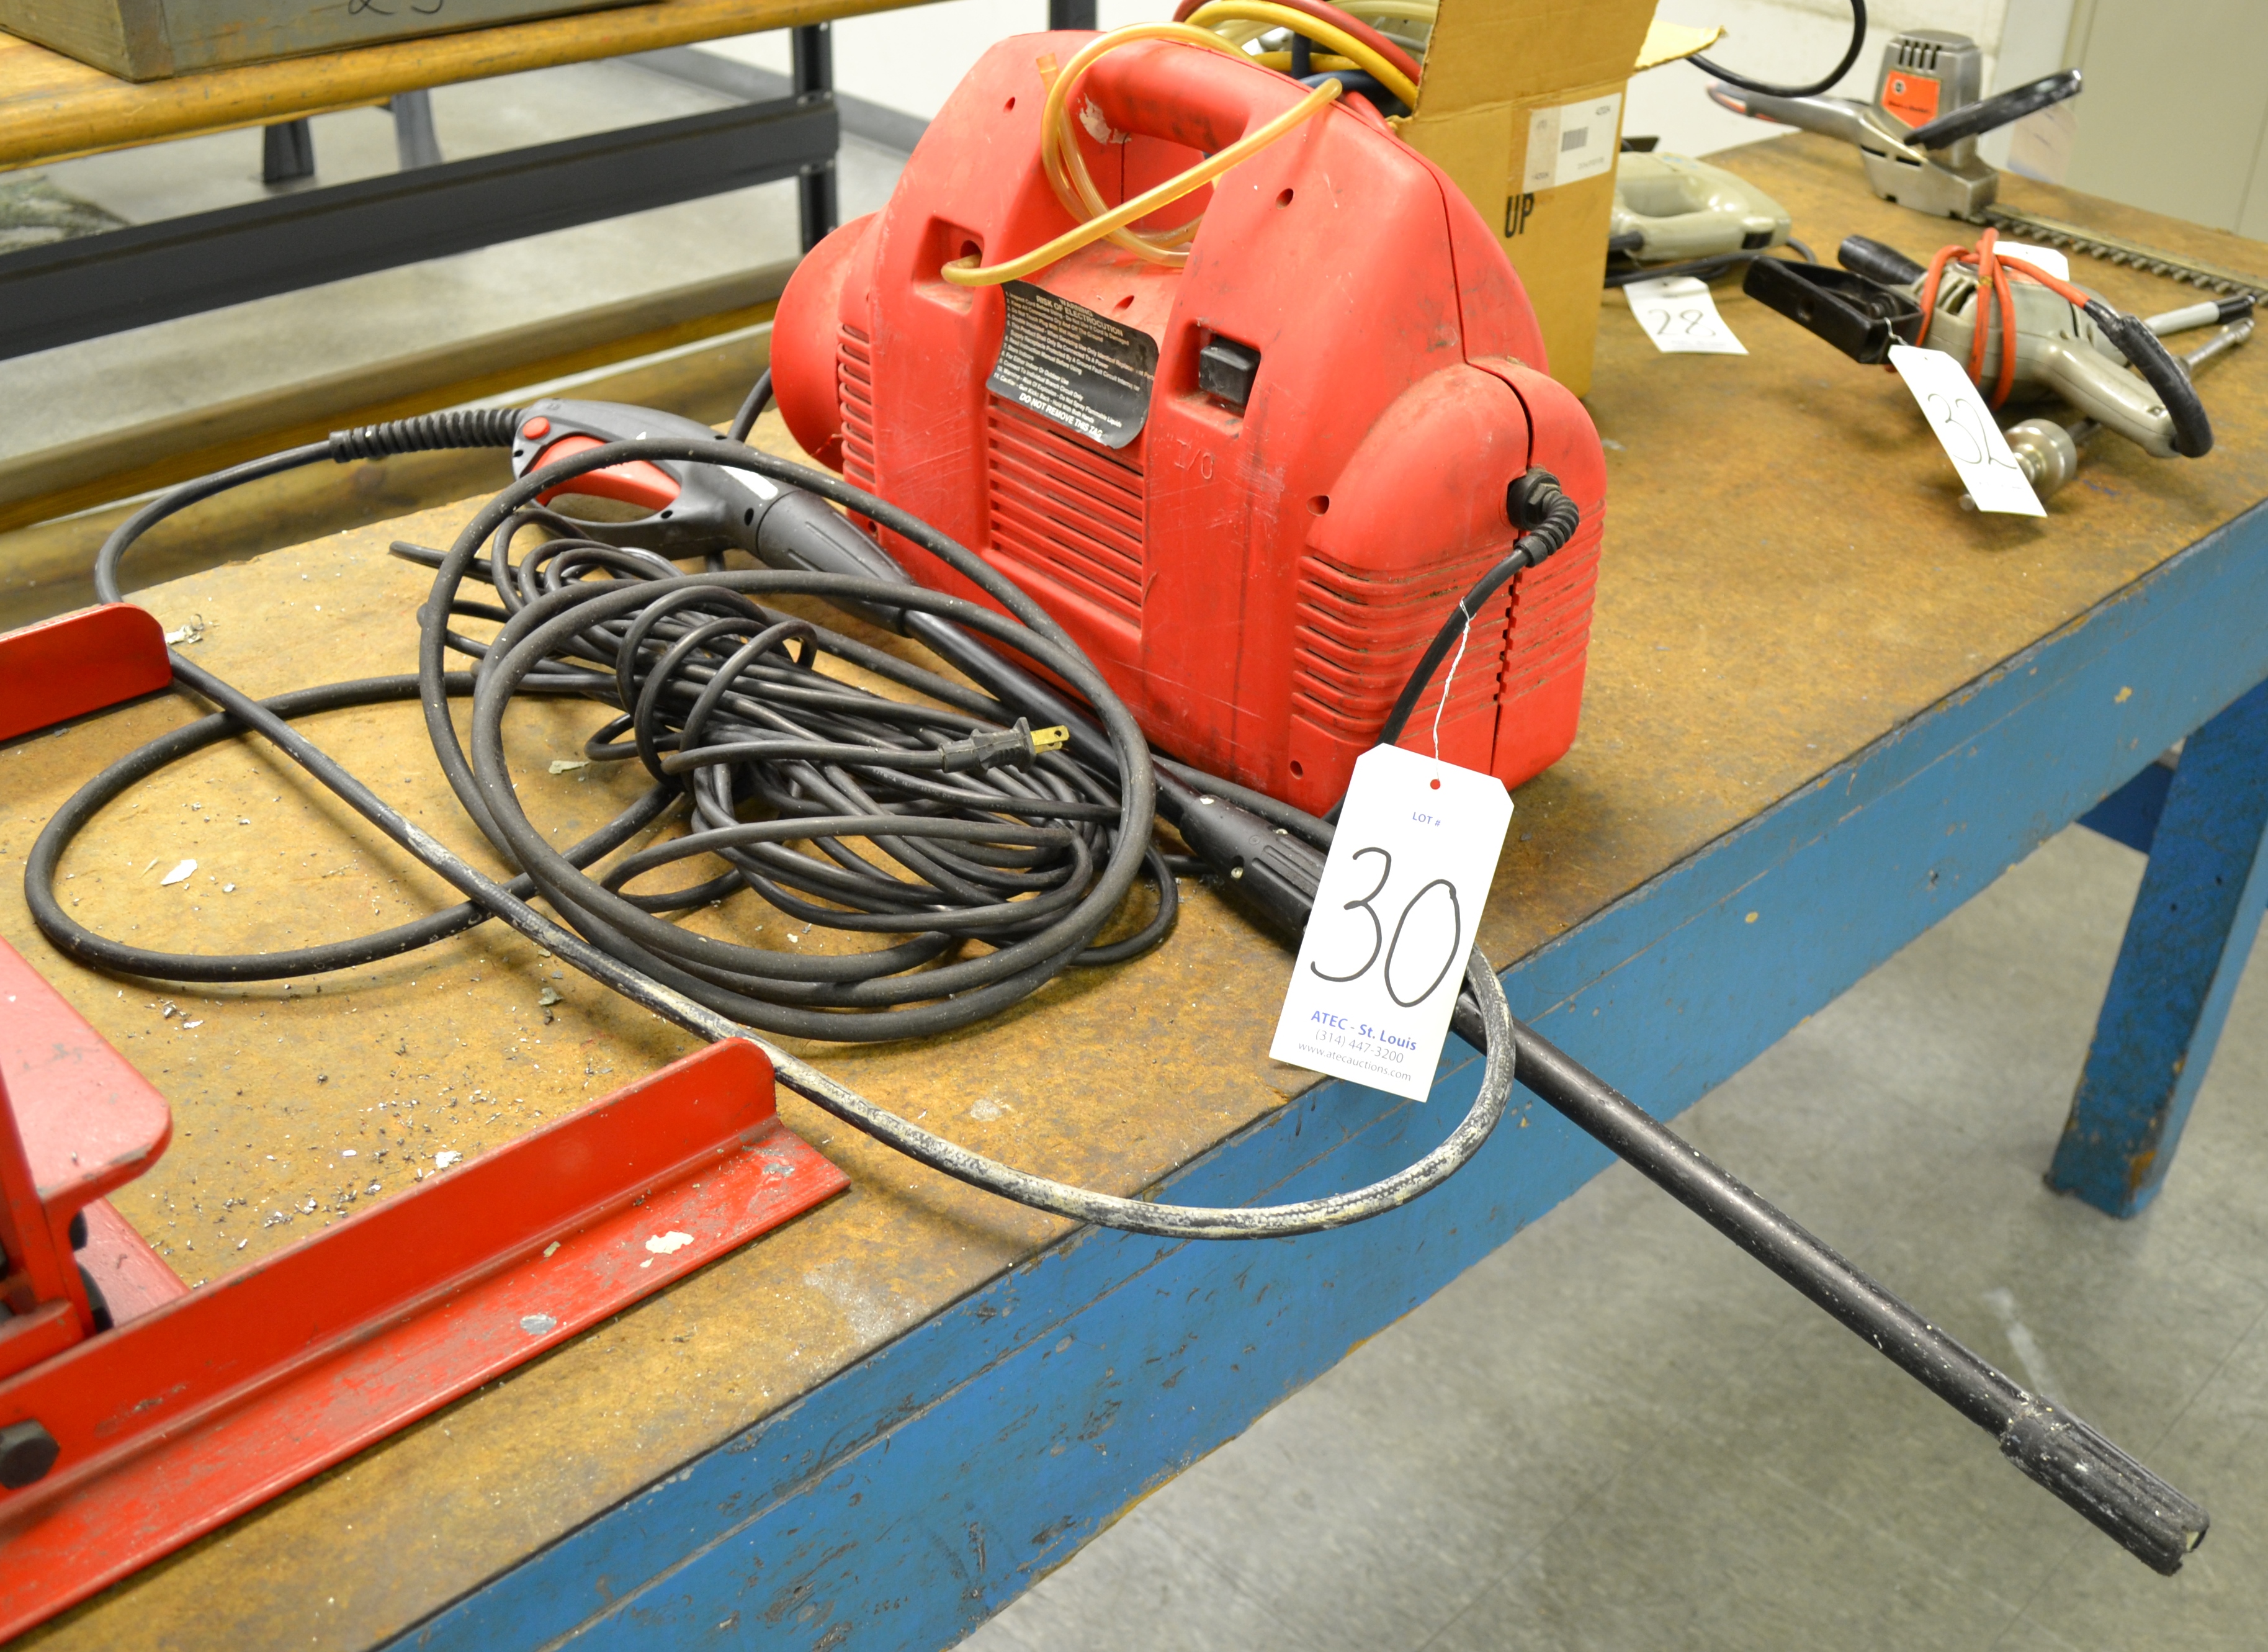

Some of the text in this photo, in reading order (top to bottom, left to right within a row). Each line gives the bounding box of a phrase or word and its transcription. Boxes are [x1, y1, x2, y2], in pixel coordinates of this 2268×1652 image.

[1504, 192, 1535, 238] UP
[1026, 313, 1038, 322] Touch
[1039, 319, 1048, 328] Plug
[1049, 323, 1058, 331] With
[1036, 295, 1123, 336] RISK OF ELECTROCUTION
[1059, 299, 1093, 316] WARNING
[1648, 308, 1716, 337] 28
[1011, 322, 1020, 330] This
[1020, 326, 1036, 337] Product
[1047, 338, 1056, 347] Only
[1063, 345, 1085, 359] Connected
[1095, 359, 1109, 369] Power
[1087, 331, 1103, 343] Ground
[1087, 347, 1097, 357] Only
[1109, 333, 1129, 346] Damaged
[1013, 356, 1025, 365] Either
[1025, 361, 1039, 371] Indoor
[1044, 370, 1060, 381] Outdoor
[1061, 377, 1069, 385] Use
[1041, 351, 1056, 362] Manual
[1056, 358, 1069, 369] Before
[1070, 364, 1082, 375] Using
[1046, 346, 1065, 358] Protected
[1076, 359, 1091, 370] Ground
[1092, 366, 1103, 375] Fault
[1103, 371, 1117, 381] Circuit
[1003, 360, 1020, 371] Connect
[1045, 379, 1059, 389] Branch
[1060, 385, 1073, 396] Circuit
[1073, 392, 1083, 402] Only
[1019, 392, 1031, 403] DO
[1031, 398, 1047, 410] NOT
[1046, 405, 1075, 424] REMOVE
[1074, 418, 1089, 431] THIS
[1039, 393, 1050, 402] Back
[1072, 408, 1081, 417] Both
[1073, 400, 1085, 411] Spray
[1107, 416, 1122, 428] Liquids
[1927, 393, 2017, 469] 32
[1412, 811, 1441, 827] LOT #
[1310, 846, 1461, 1008] 30
[1311, 1009, 1348, 1031] ATEC
[1358, 1022, 1376, 1040] St.
[1379, 1029, 1417, 1051] Louis
[1298, 1041, 1412, 1082] www.atecauctions.com
[1315, 1028, 1404, 1065] (314) 447-3200
